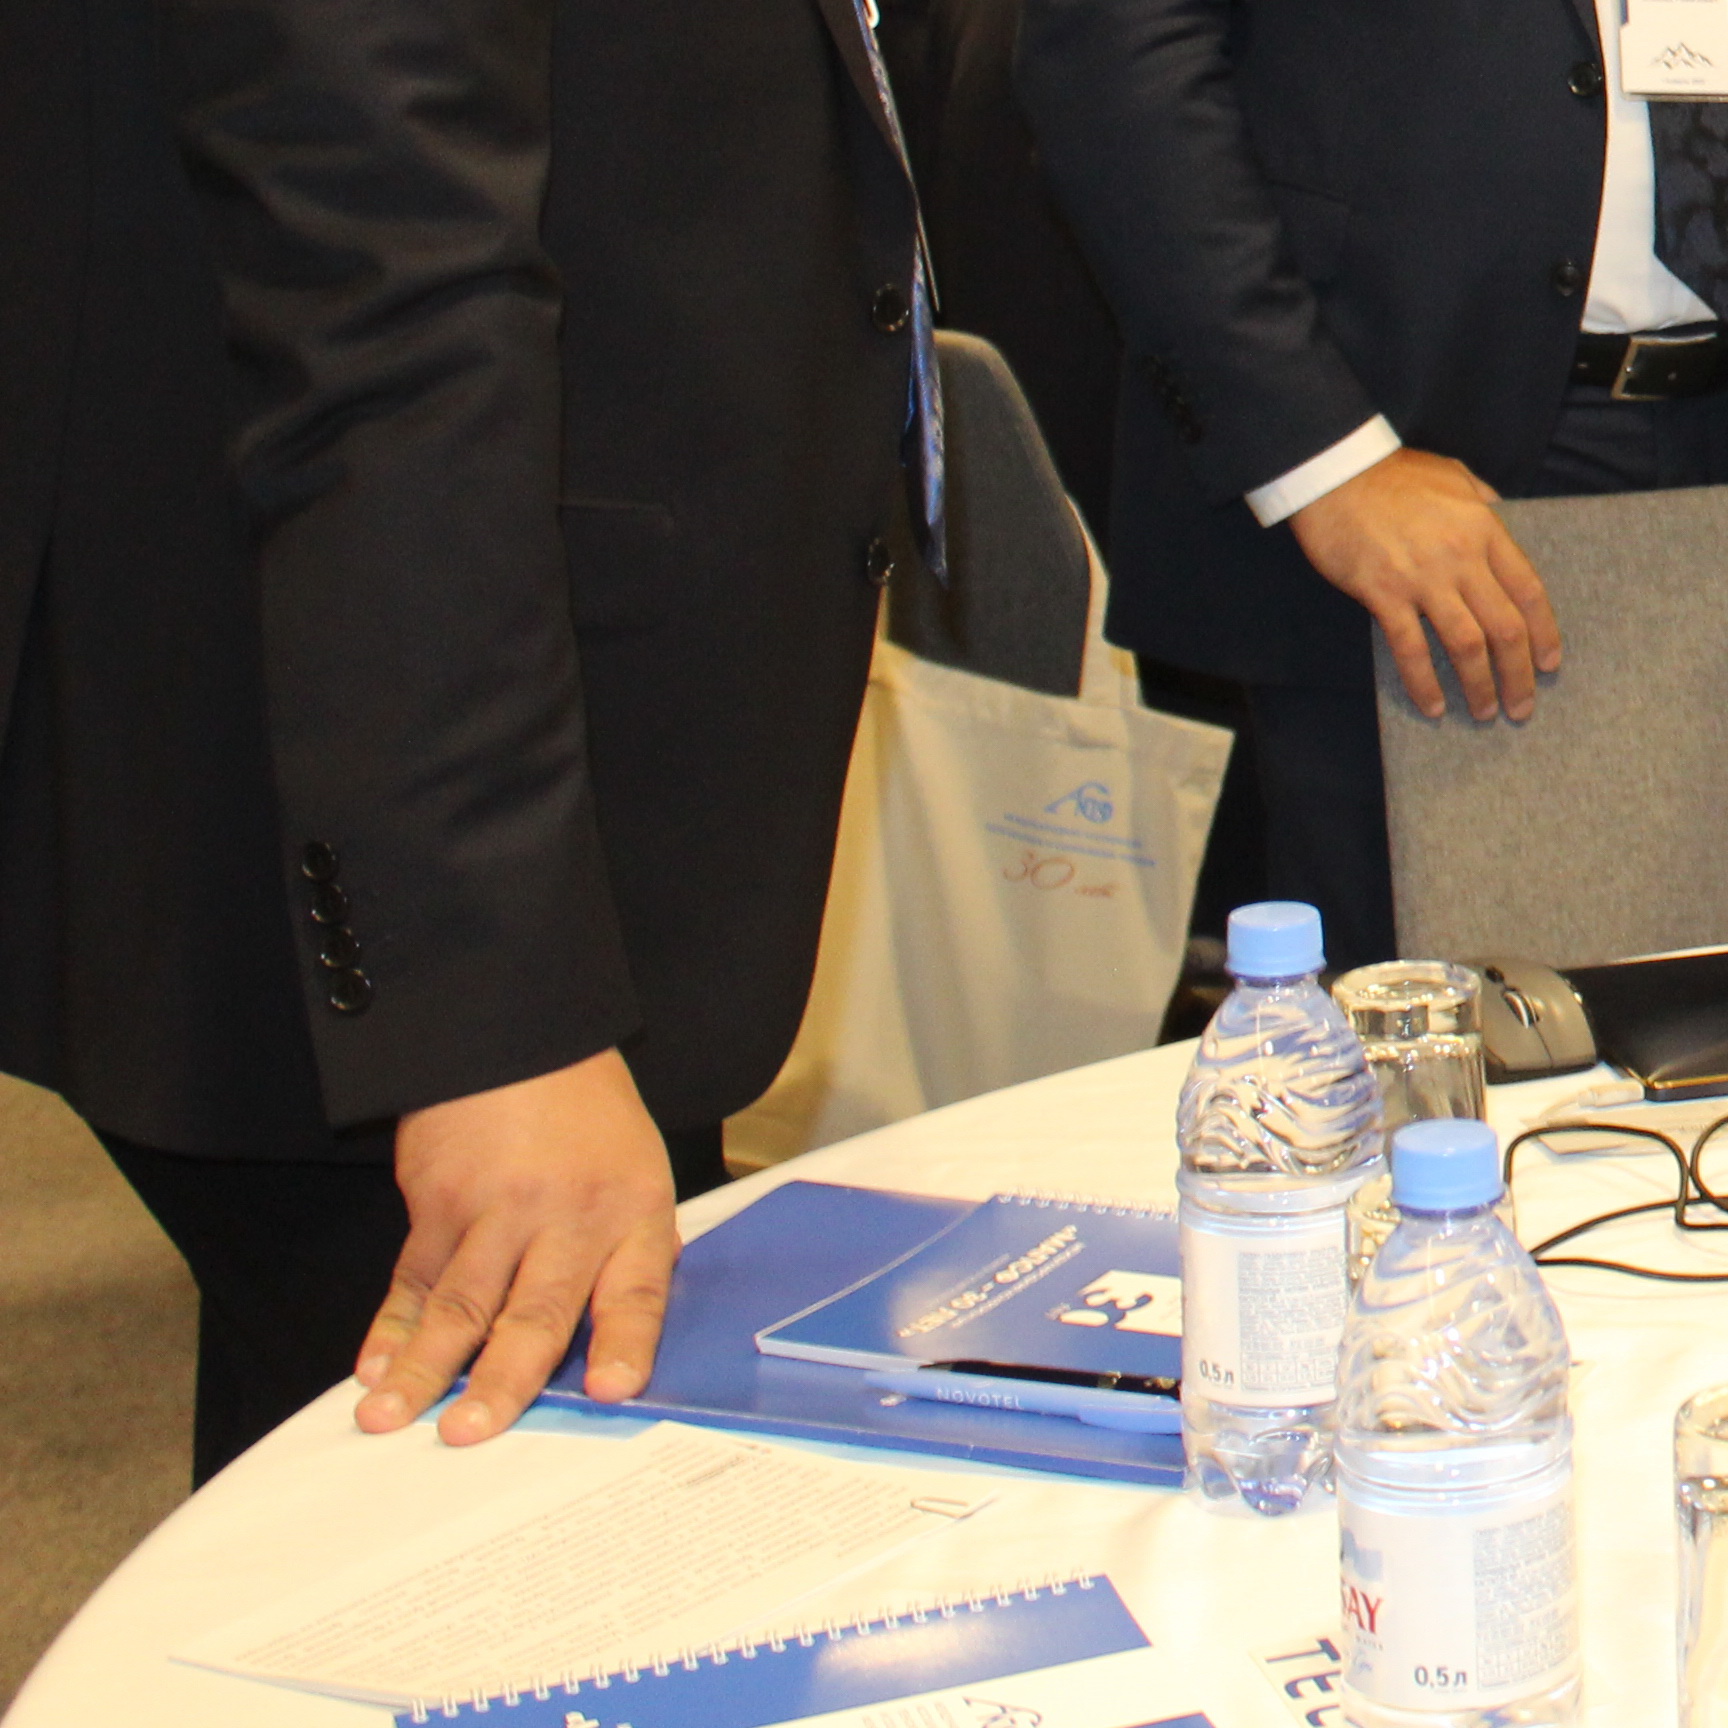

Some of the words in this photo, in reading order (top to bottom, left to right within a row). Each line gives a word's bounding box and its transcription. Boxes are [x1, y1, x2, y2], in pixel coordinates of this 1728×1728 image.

[1199, 1359, 1222, 1382] 0,5
[936, 1386, 1024, 1412] NOVOTEL
[1413, 1665, 1450, 1689] 0,5
